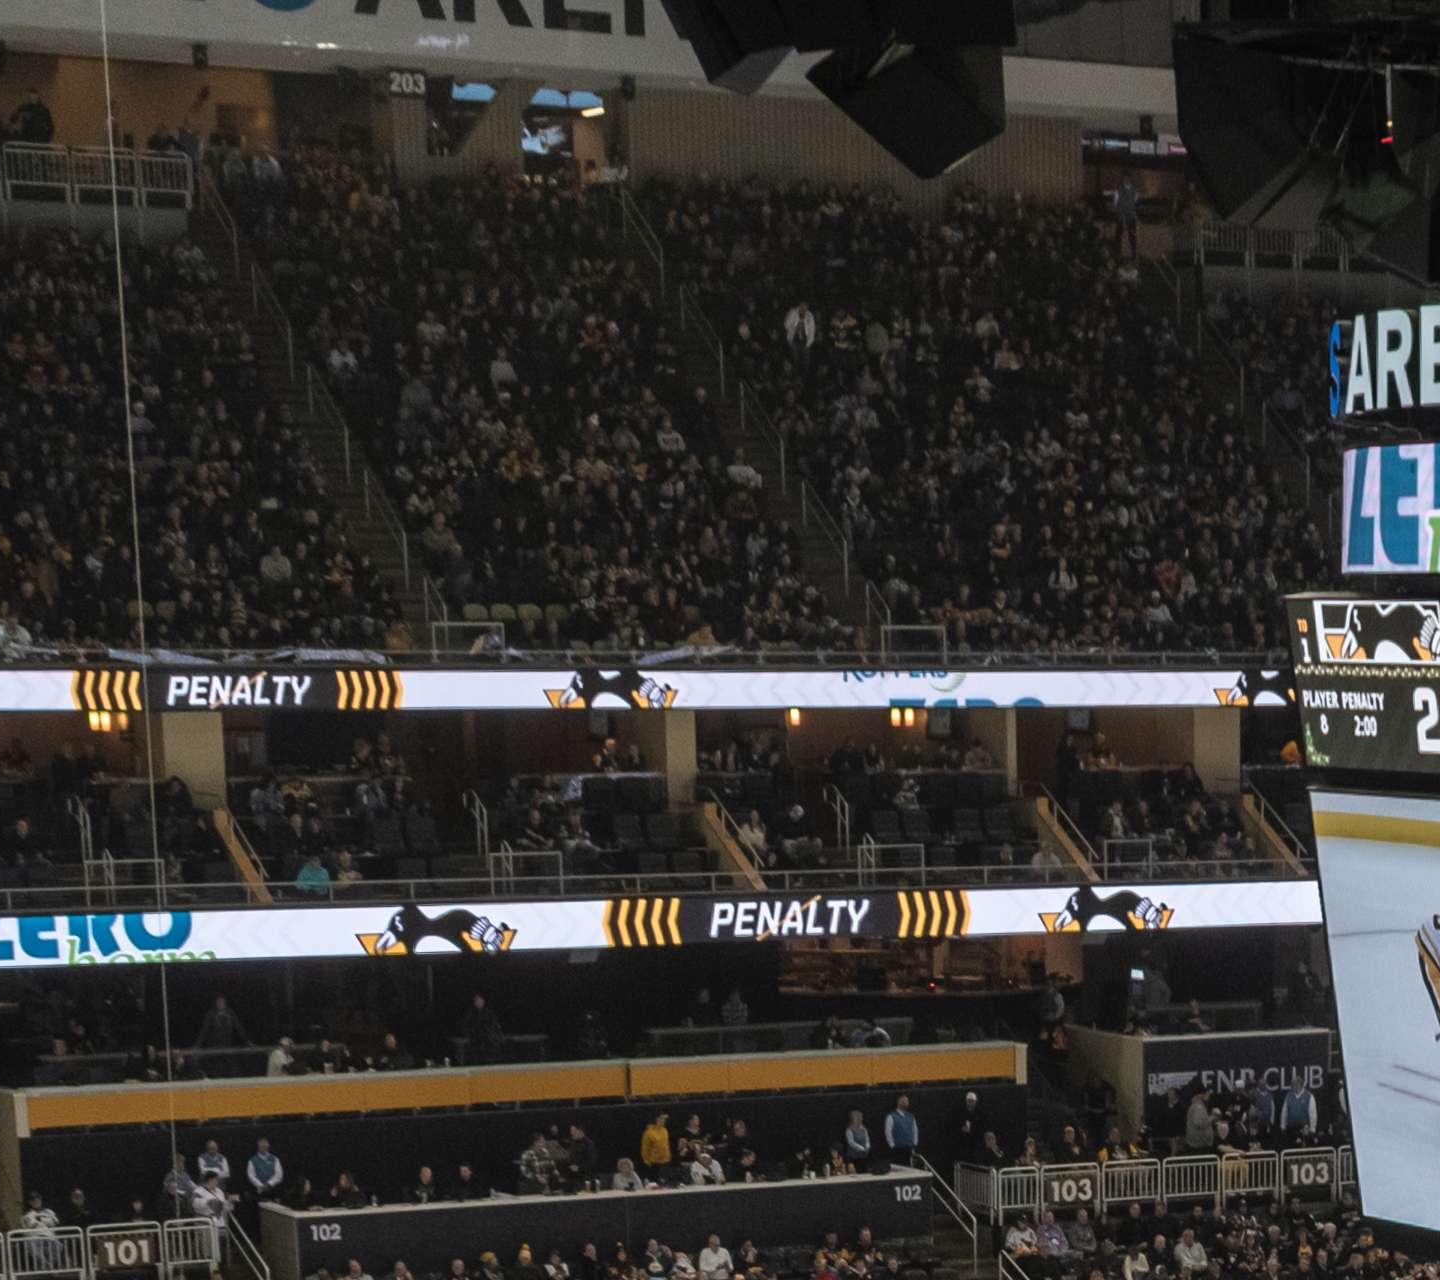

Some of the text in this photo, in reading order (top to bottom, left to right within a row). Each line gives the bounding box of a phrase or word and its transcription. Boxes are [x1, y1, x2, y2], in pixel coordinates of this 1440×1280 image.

[389, 71, 426, 95] 203
[166, 674, 312, 706] PENALTY
[1302, 689, 1384, 711] PLAYER PENALTY
[1354, 715, 1377, 737] 2:00
[710, 898, 869, 938] PENALTY
[1290, 1163, 1329, 1185] 103
[1050, 1178, 1092, 1202] 103
[310, 1223, 341, 1241] 102
[103, 1239, 150, 1265] 101
